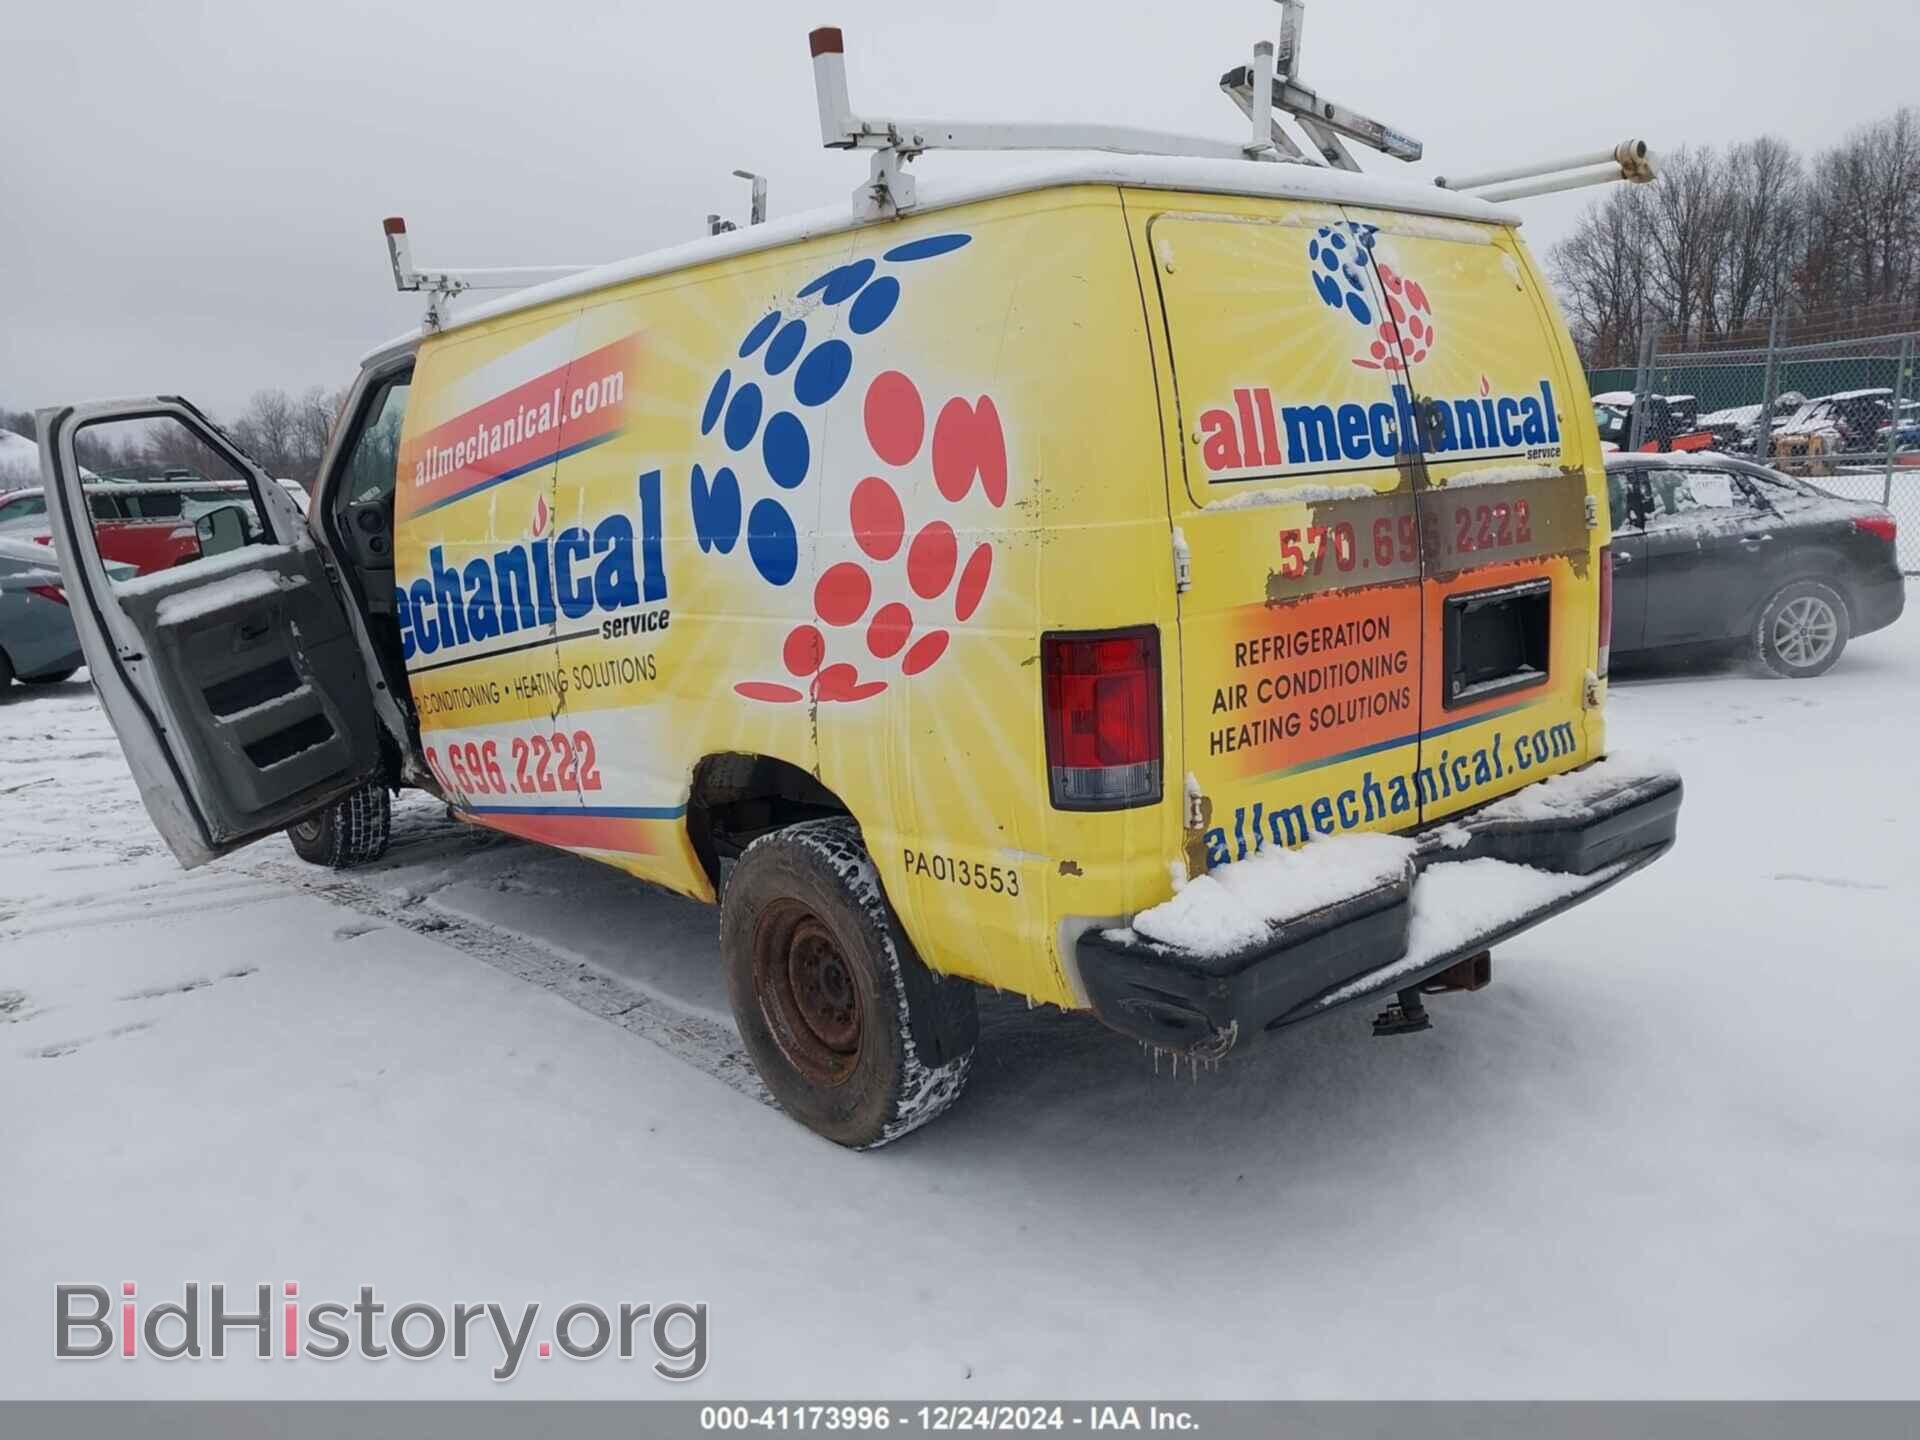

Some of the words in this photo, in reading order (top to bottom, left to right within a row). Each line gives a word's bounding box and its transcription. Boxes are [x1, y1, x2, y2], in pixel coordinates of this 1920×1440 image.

[415, 371, 625, 488] allmechanical.com
[1527, 447, 1561, 460] service
[602, 608, 670, 640] service
[1235, 616, 1390, 668] REFRIGERATION
[424, 682, 500, 714] CONDITIONING
[515, 669, 568, 701] HEATING
[573, 654, 657, 692] SOLUTIONS
[1212, 684, 1247, 715] AIR
[1257, 650, 1409, 704] CONDITIONING
[1210, 711, 1301, 757] HEATING
[1309, 687, 1410, 732] SOLUTIONS
[1203, 720, 1577, 869] allmechanical.com
[904, 848, 1020, 897] PA013553
